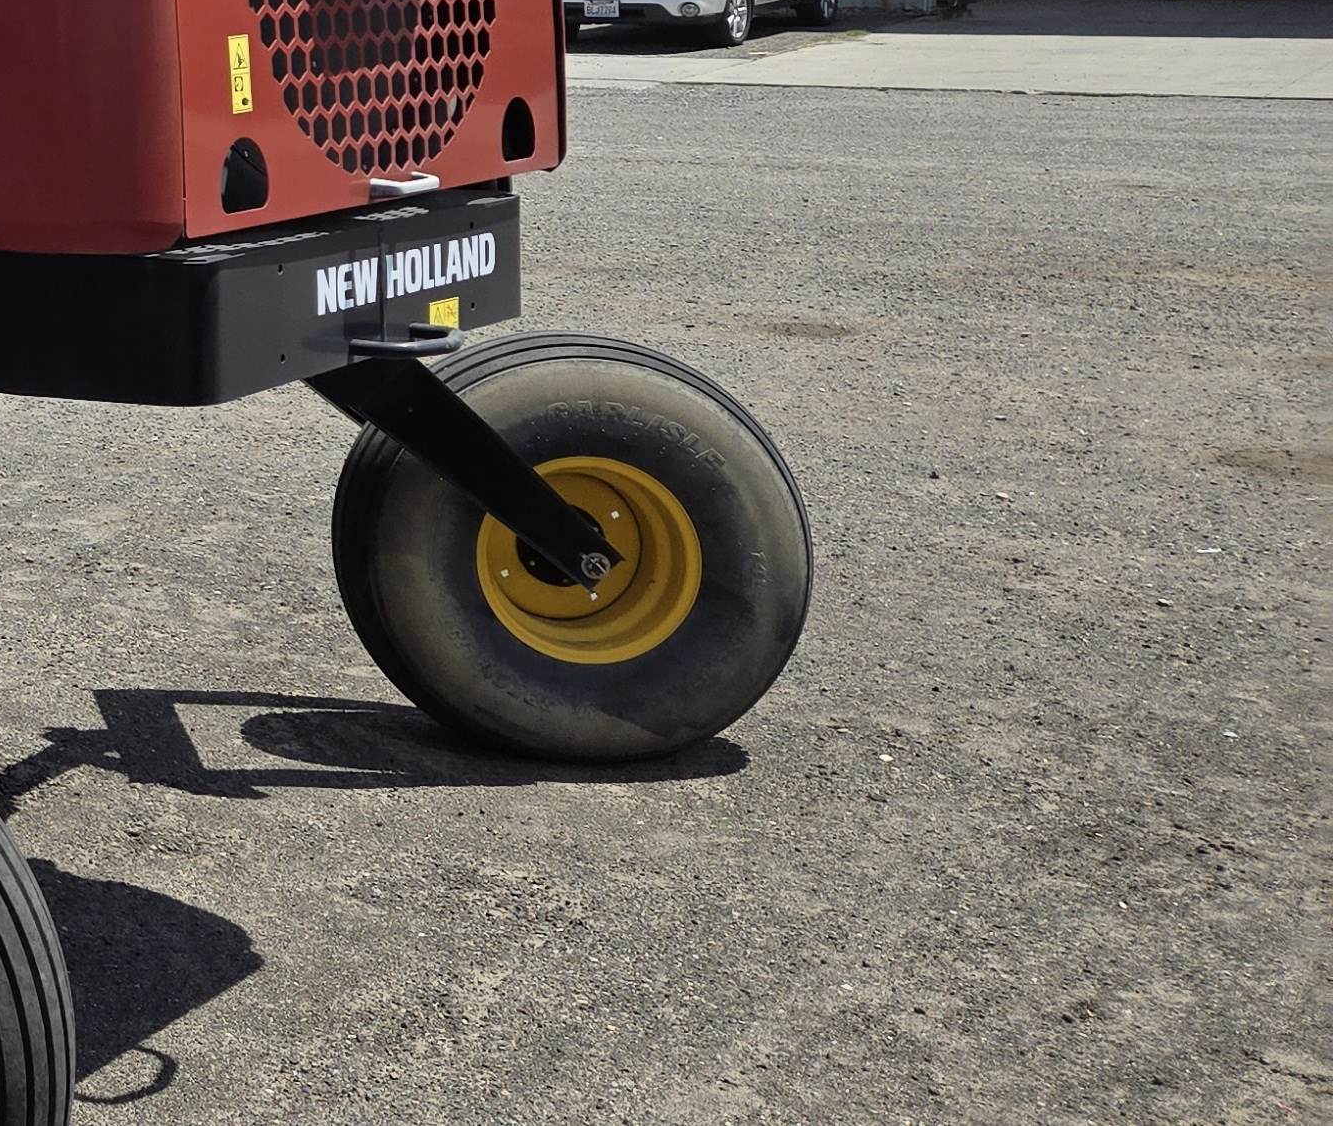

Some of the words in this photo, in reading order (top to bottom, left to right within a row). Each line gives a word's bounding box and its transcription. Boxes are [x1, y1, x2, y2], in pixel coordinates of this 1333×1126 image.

[316, 257, 379, 316] NEW
[385, 232, 497, 299] HOLLAND
[546, 399, 727, 471] CARLISLE
